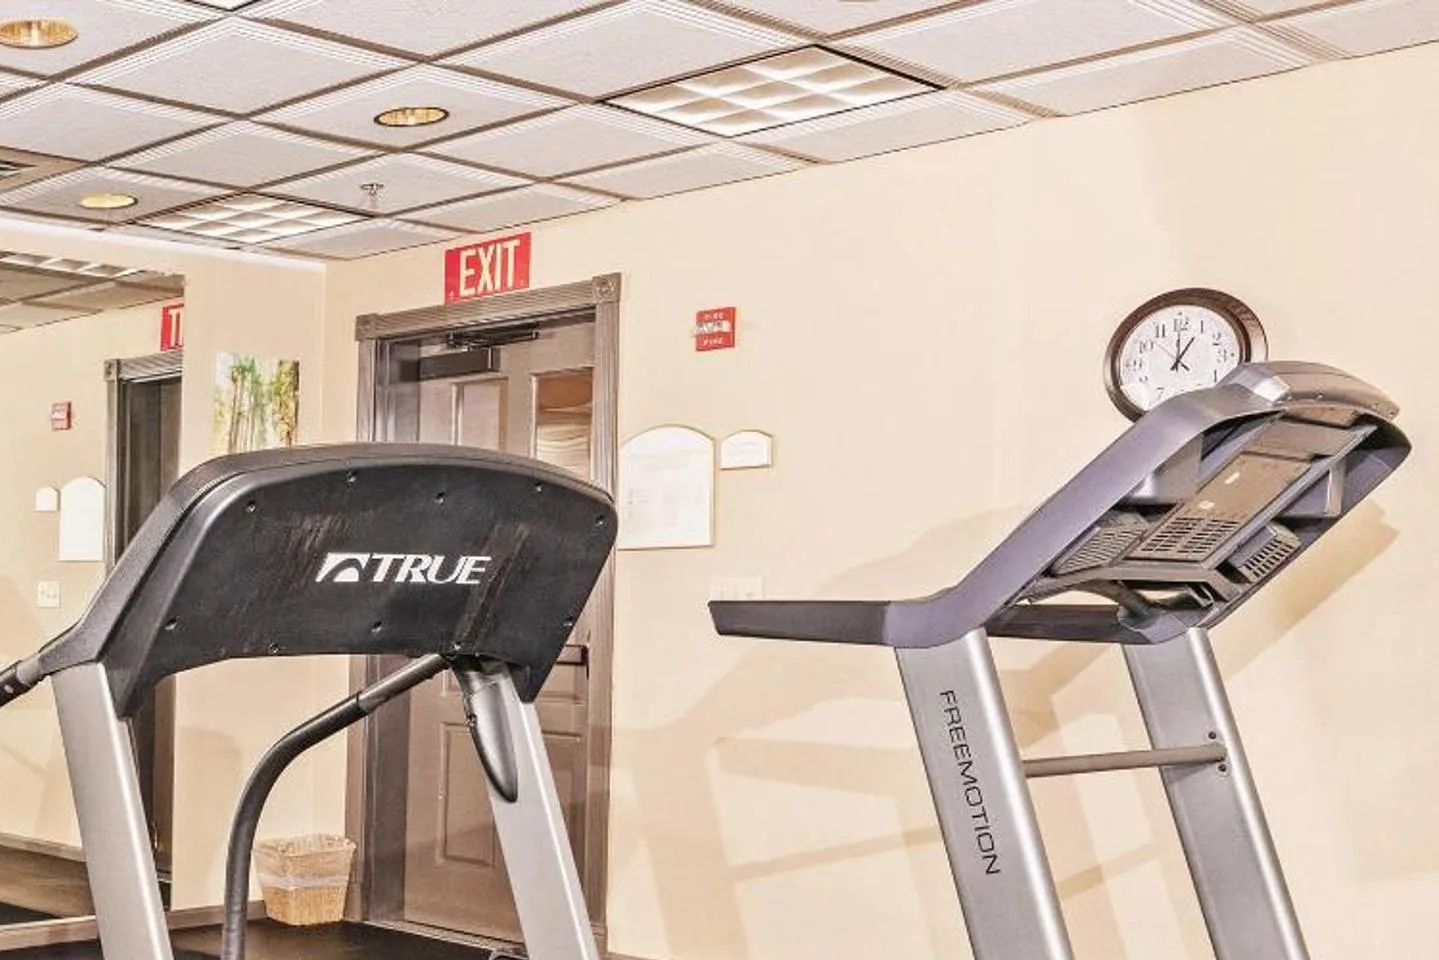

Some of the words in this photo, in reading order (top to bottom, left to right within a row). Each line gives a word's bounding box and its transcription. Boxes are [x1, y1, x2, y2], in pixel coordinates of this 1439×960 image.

[460, 239, 521, 297] EXIT
[371, 552, 493, 585] TRUE
[939, 689, 1001, 876] FREEMOTION
